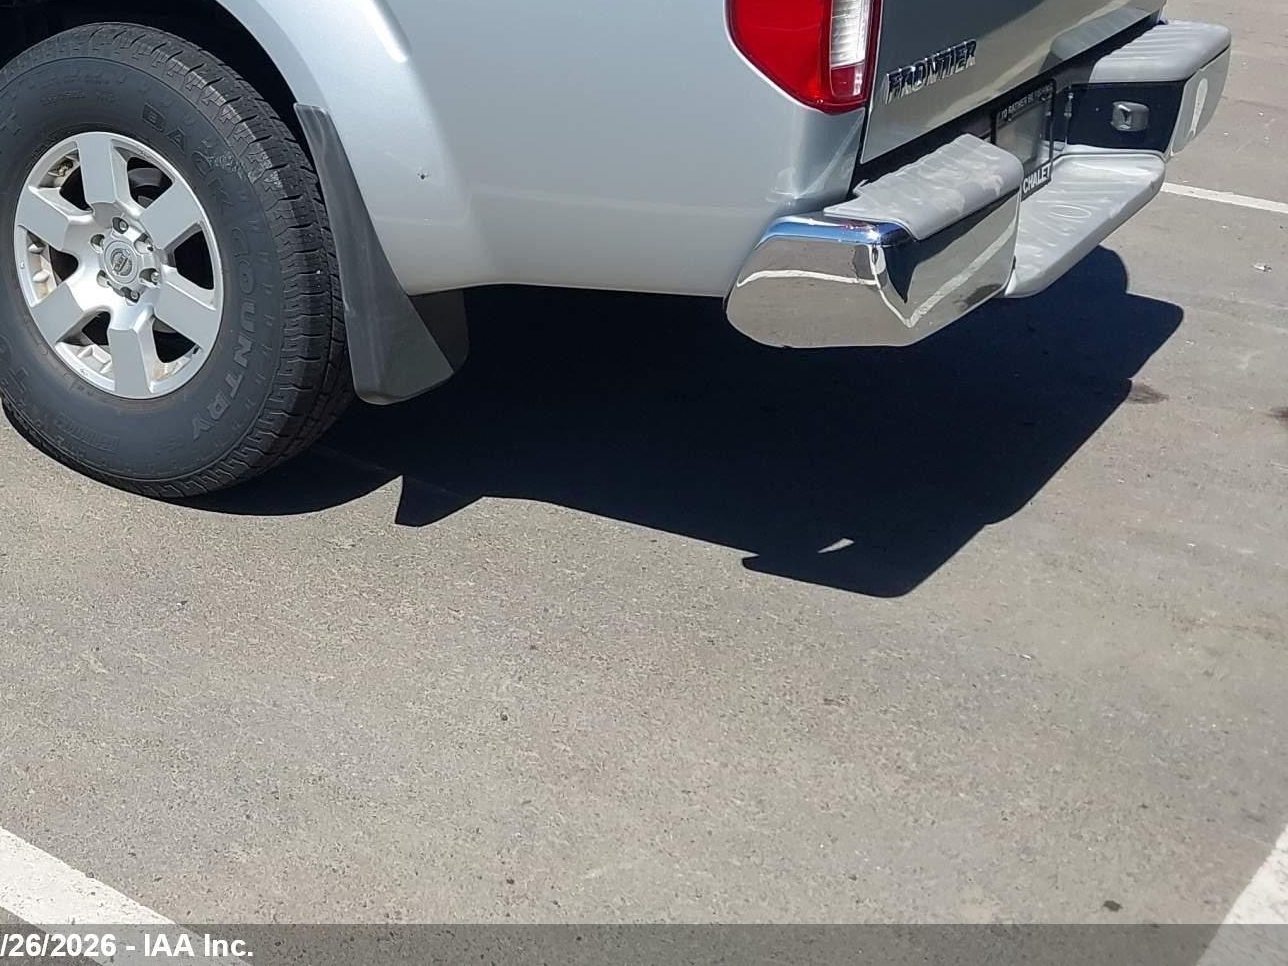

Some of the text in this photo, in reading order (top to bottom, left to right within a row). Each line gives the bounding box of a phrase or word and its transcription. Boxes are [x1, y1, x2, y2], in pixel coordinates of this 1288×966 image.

[886, 39, 977, 104] FRONTIER
[1022, 163, 1052, 194] CHALET
[190, 226, 256, 441] COUNTRY
